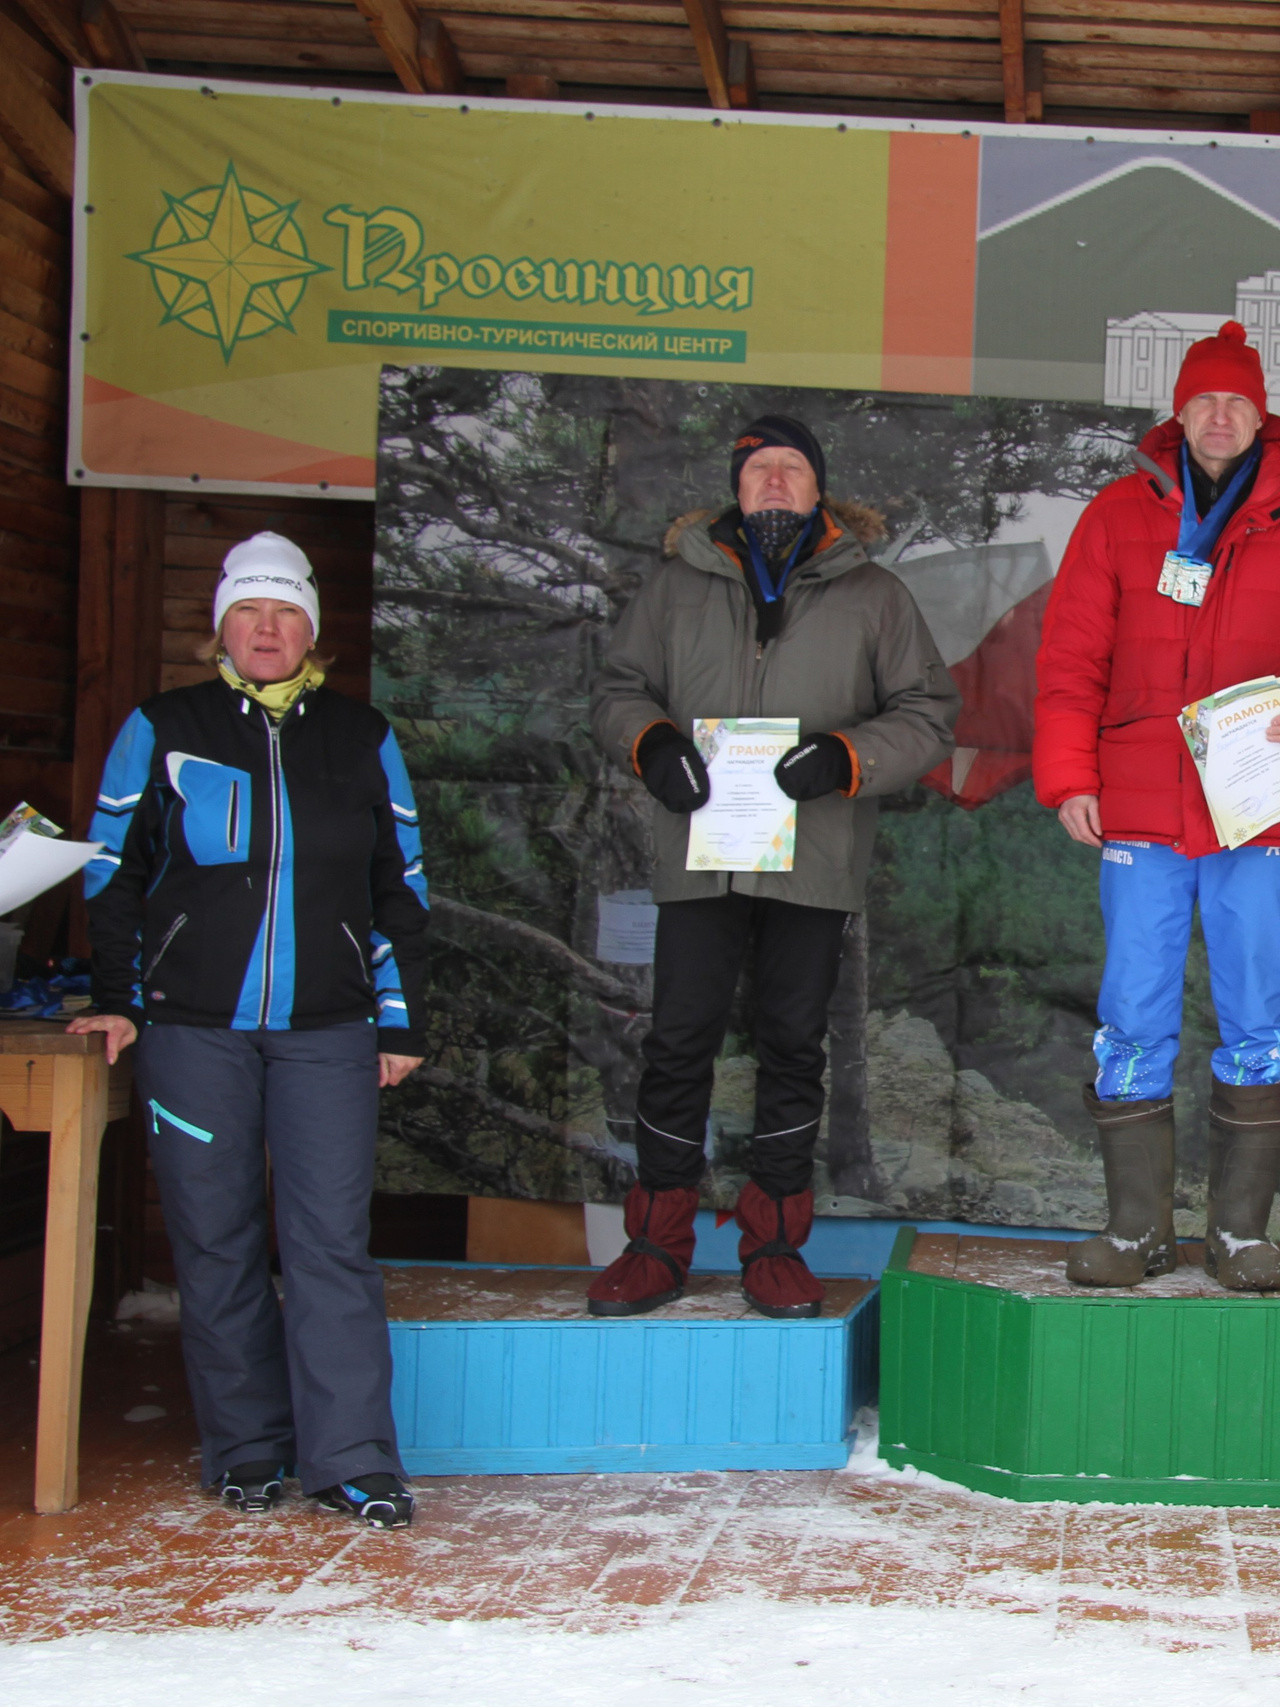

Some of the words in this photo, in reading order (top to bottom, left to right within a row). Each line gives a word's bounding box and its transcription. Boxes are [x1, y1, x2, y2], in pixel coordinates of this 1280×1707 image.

[323, 203, 753, 316] Провинция
[342, 319, 659, 352] СПОРТИВНО-ТУРИСТИЧЕСКИЙ
[664, 336, 732, 356] ЦЕНТР
[233, 575, 296, 588] FISCHER
